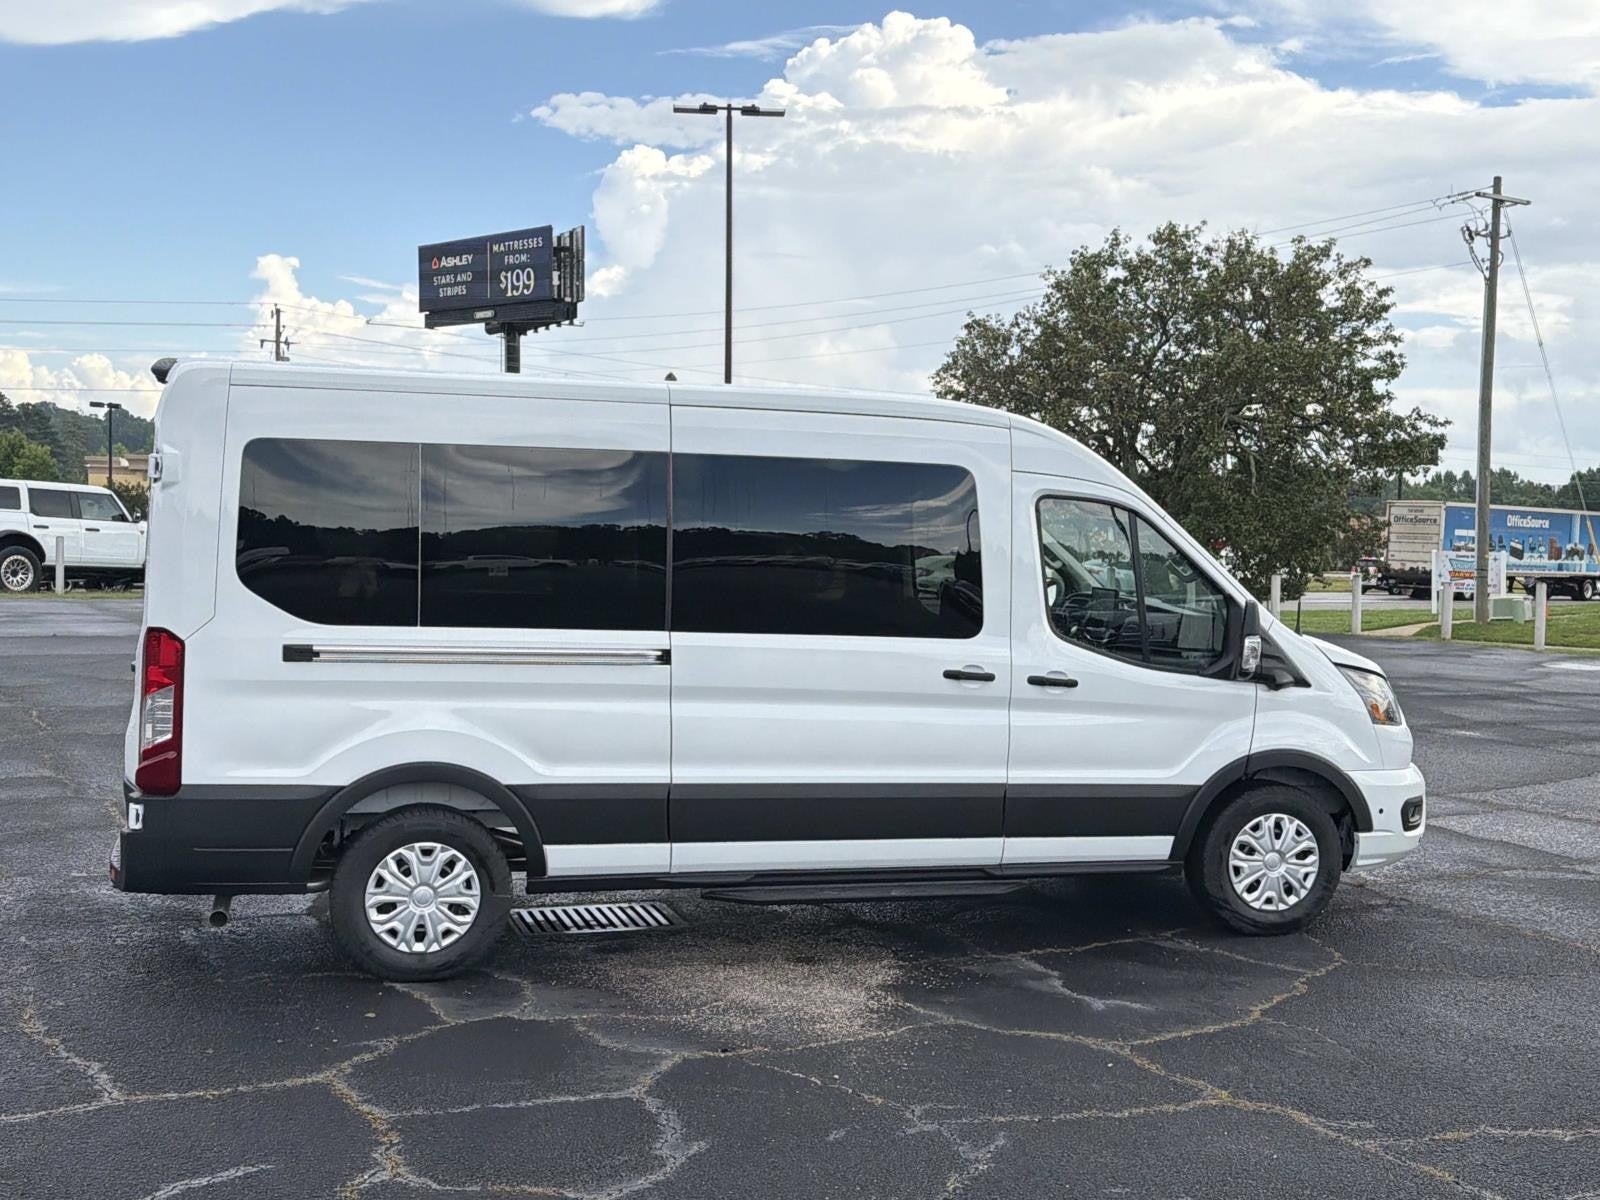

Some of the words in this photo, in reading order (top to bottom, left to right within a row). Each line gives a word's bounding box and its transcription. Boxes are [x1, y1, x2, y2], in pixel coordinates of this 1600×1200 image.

[492, 237, 543, 253] MATTRESSES
[440, 254, 473, 267] ASHLEY
[504, 253, 531, 265] FROM:
[433, 273, 455, 286] STARS
[456, 271, 473, 283] AND
[500, 268, 534, 296] $199
[439, 285, 467, 298] STRIPES
[1393, 515, 1438, 524] OfficeSource
[1507, 515, 1550, 528] OfficeSource
